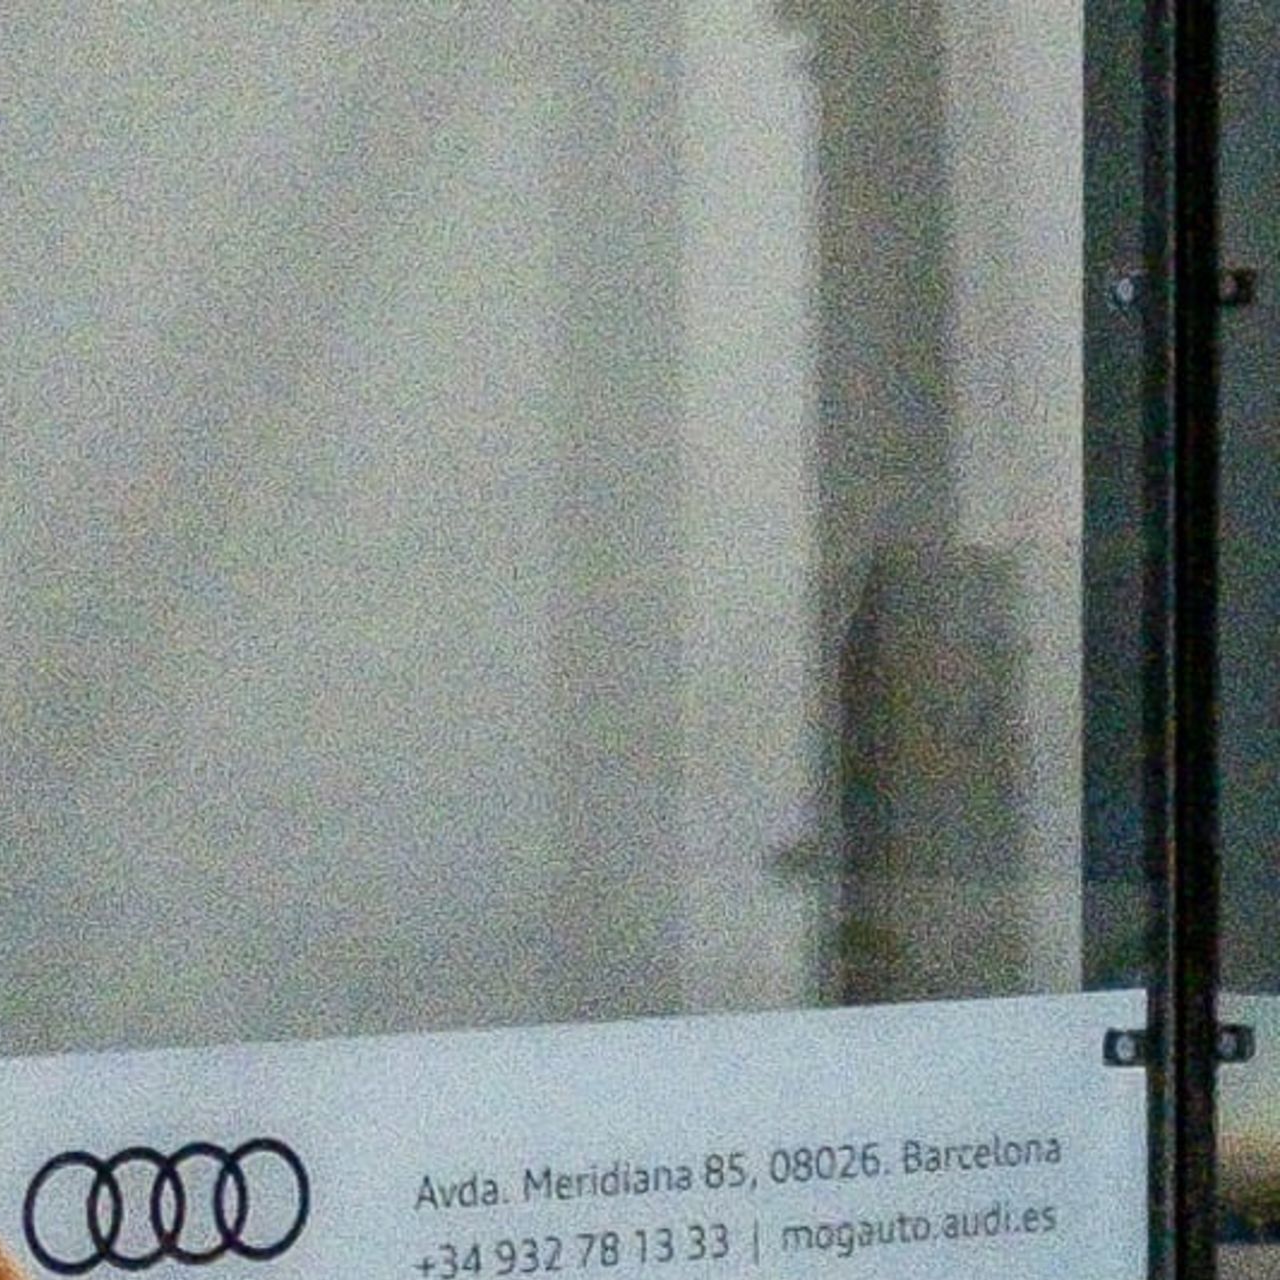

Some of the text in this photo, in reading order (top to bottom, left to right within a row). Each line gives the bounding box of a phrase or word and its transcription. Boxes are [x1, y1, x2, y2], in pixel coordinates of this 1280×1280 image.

[414, 1133, 1062, 1211] Avda. Meridiana 85, 08026. Barcelona
[493, 1234, 563, 1277] 932
[576, 1230, 621, 1269] 78
[634, 1226, 676, 1265] 13
[687, 1221, 730, 1262] 33
[781, 1202, 1057, 1259] mogauto.audi.es
